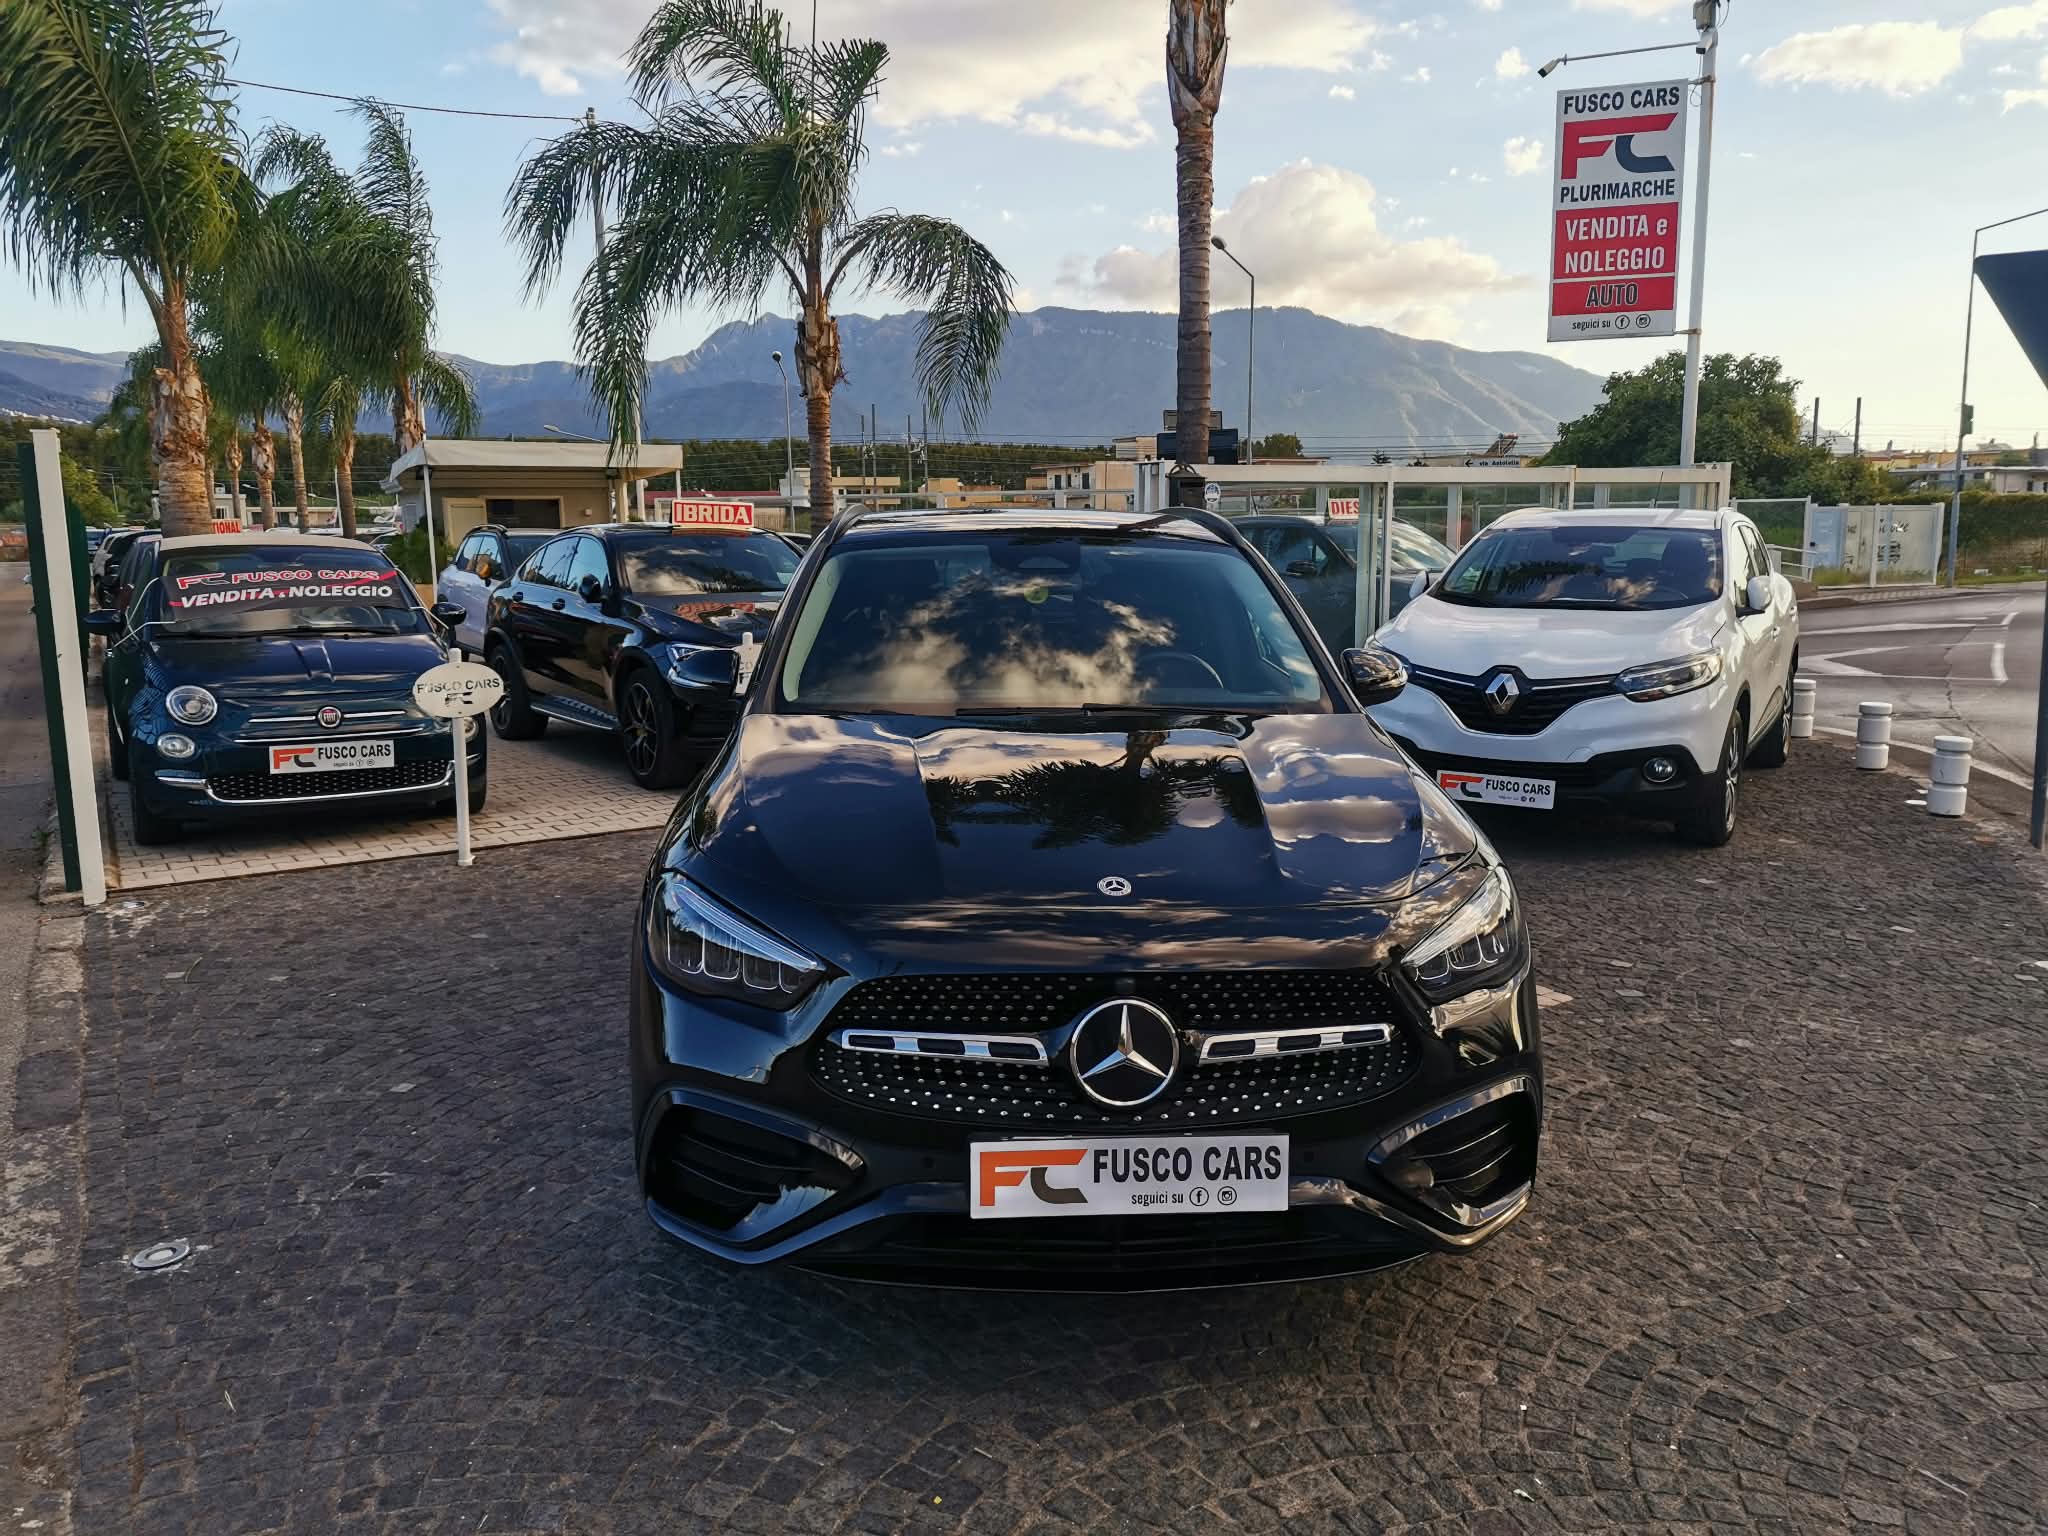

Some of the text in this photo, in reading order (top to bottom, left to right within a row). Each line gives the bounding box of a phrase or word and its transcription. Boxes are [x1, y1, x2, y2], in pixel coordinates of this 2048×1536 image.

[1563, 86, 1680, 115] FUSCO CARS
[1560, 178, 1676, 203] PLURIMARCHE
[1565, 214, 1668, 241] VENDITA e
[1564, 246, 1665, 274] NOLEGGIO
[1585, 282, 1638, 308] AUTO
[1572, 316, 1611, 331] seguici su
[675, 503, 750, 524] IBRIDA
[231, 570, 313, 584] FUSCO
[317, 569, 380, 581] CARS
[181, 587, 275, 608] VENDITA
[288, 585, 393, 598] NOLEGGIO
[465, 678, 500, 690] CARS
[318, 747, 357, 760] FUSCO
[360, 744, 391, 757] CARS
[1486, 779, 1520, 793] FUSCO
[1522, 783, 1551, 796] CARS
[1093, 1147, 1192, 1183] FUSCO
[1203, 1145, 1282, 1181] CARS
[1131, 1190, 1184, 1207] seguici su
